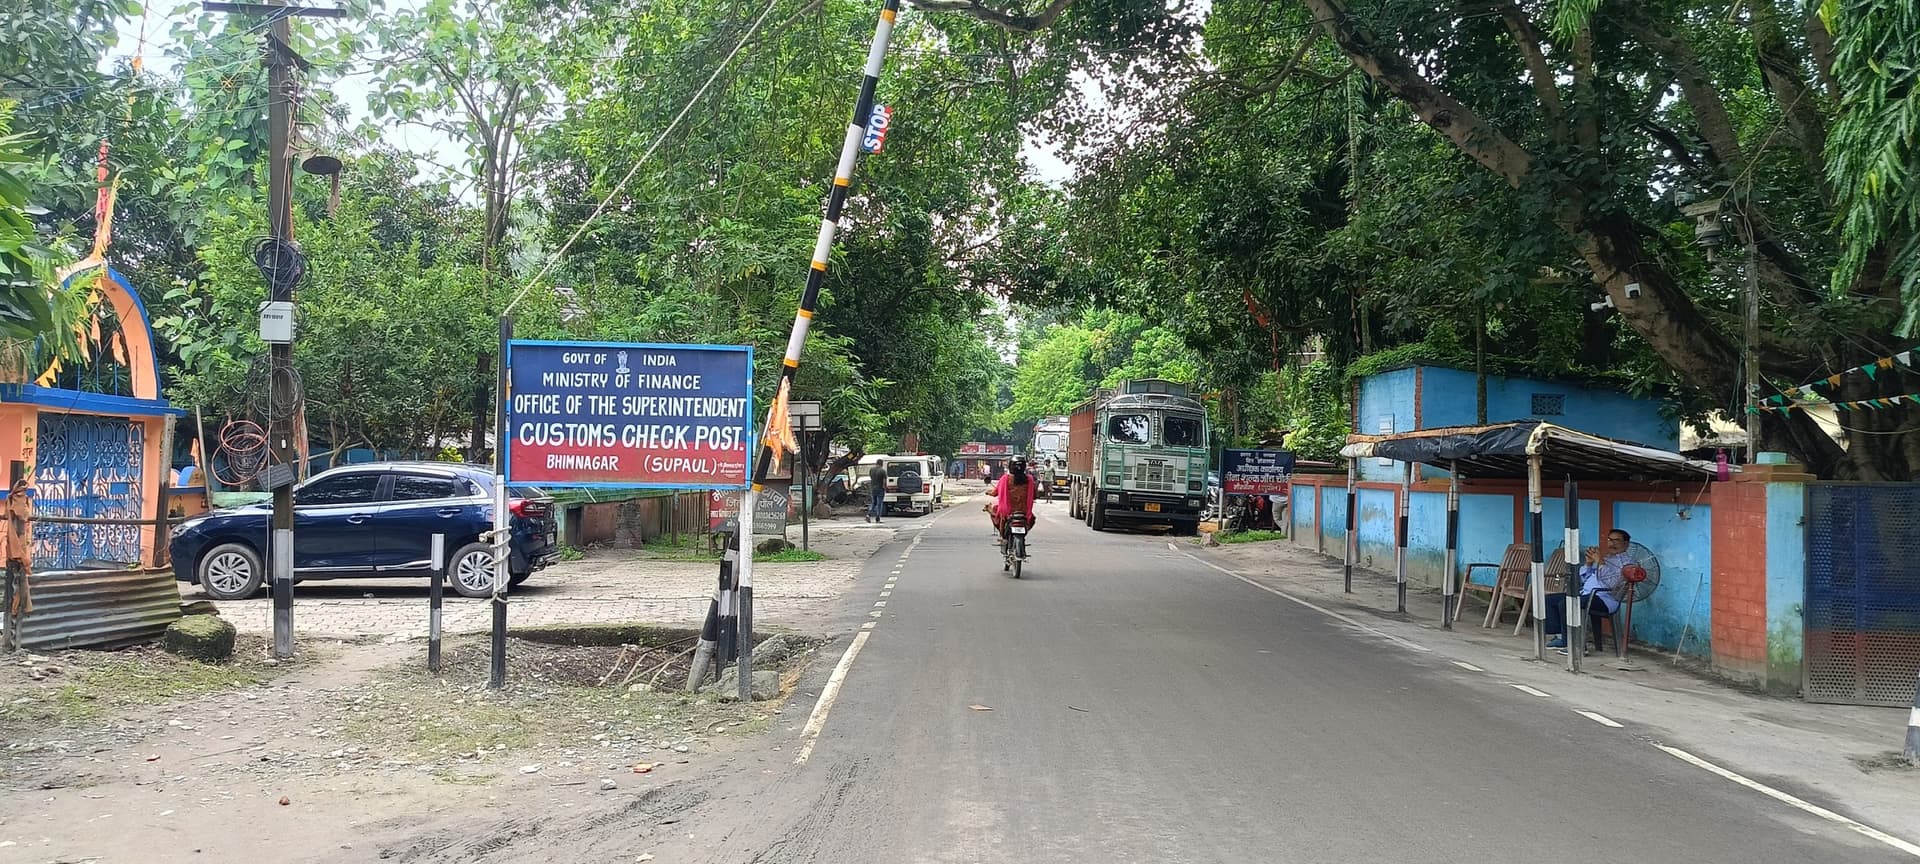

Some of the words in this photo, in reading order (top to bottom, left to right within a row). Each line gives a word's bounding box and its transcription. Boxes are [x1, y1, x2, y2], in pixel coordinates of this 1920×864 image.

[864, 104, 891, 150] STOP
[562, 353, 591, 364] GOVT
[594, 354, 607, 365] OF
[643, 354, 677, 367] INDIA
[543, 372, 609, 388] MINISTRY
[615, 373, 630, 389] OF
[638, 375, 701, 390] FINANCE
[514, 394, 561, 414] OFFICE
[565, 395, 582, 415] OF
[589, 395, 617, 416] THE
[622, 396, 747, 418] SUPERINTENDENT
[519, 422, 617, 448] CUSTOMS
[621, 424, 691, 450] CHECK
[694, 426, 745, 451] POST.
[546, 454, 619, 471] BHIMNAGAR
[643, 456, 717, 476] (SUPAUL)
